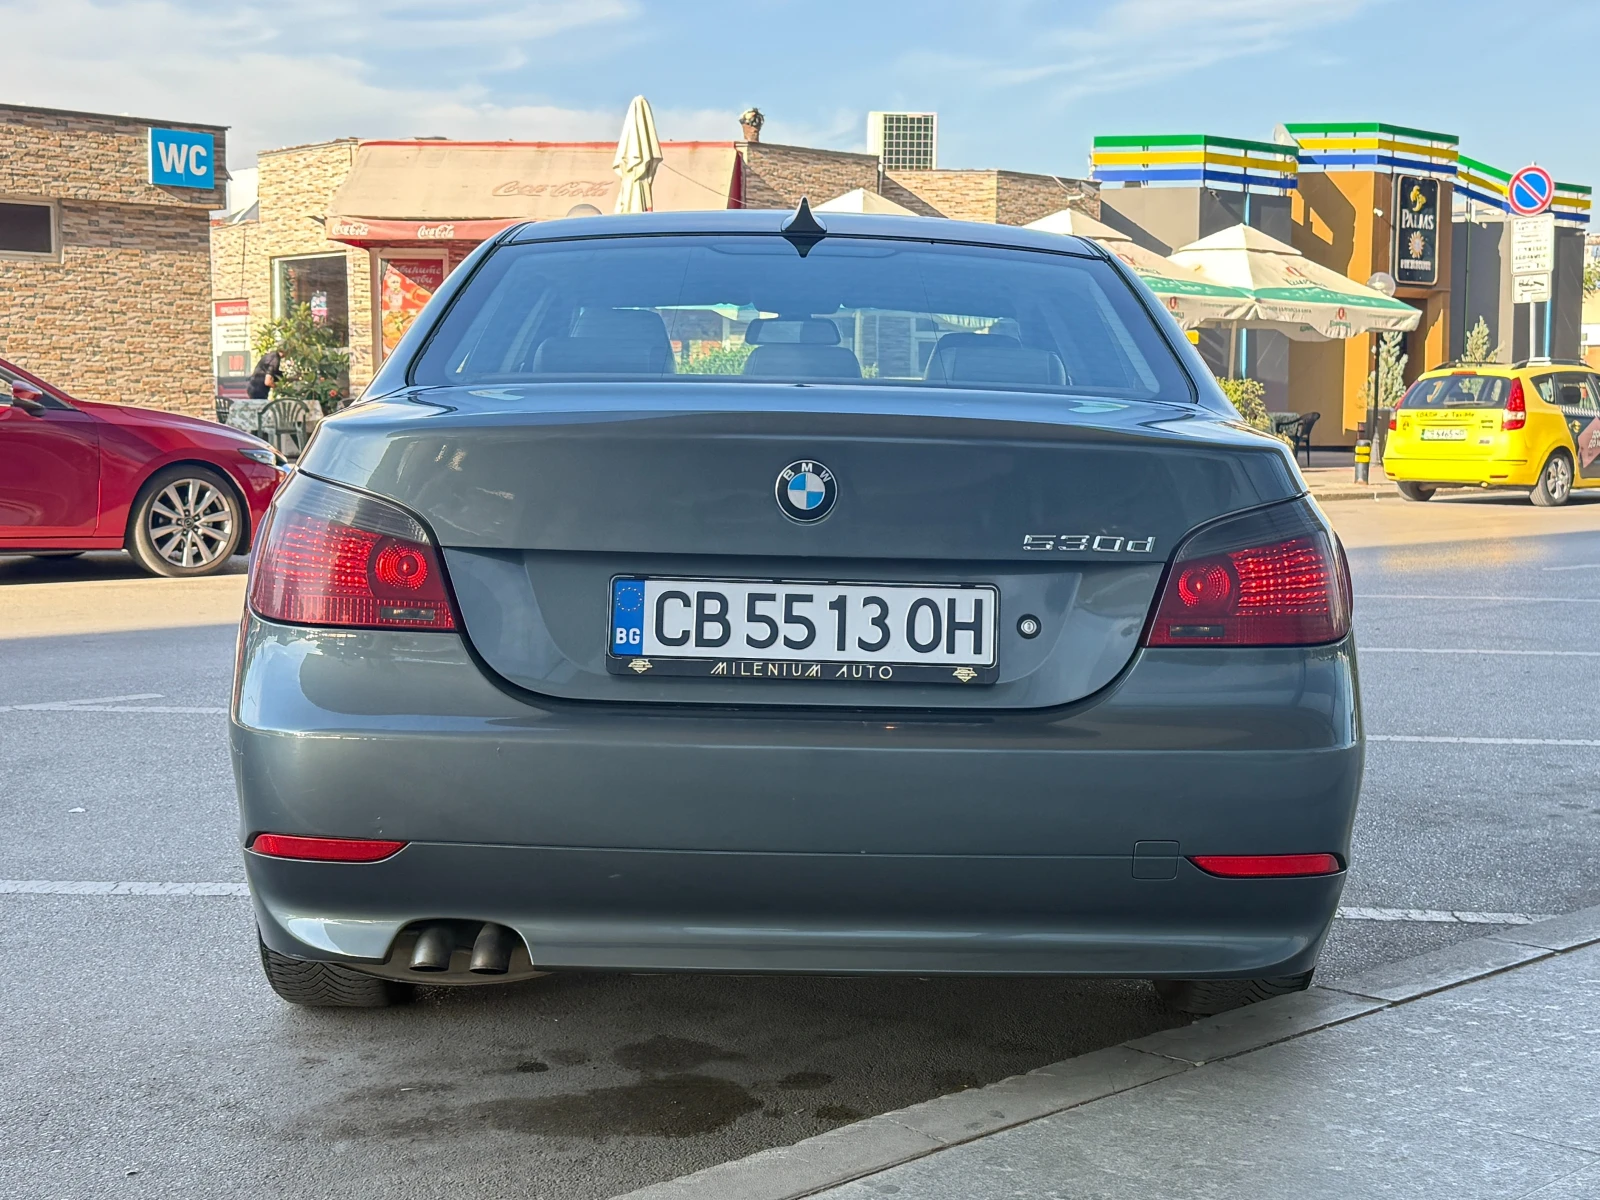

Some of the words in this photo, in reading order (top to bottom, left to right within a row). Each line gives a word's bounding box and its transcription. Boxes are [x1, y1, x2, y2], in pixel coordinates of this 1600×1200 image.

[157, 141, 207, 176] WC
[783, 462, 831, 483] BMW
[1023, 534, 1156, 553] 530d
[654, 590, 732, 648] CB
[745, 592, 891, 652] 5513
[905, 597, 984, 655] OH
[615, 628, 641, 645] BG
[710, 661, 822, 678] MILENIUM
[836, 665, 894, 680] AUTO
